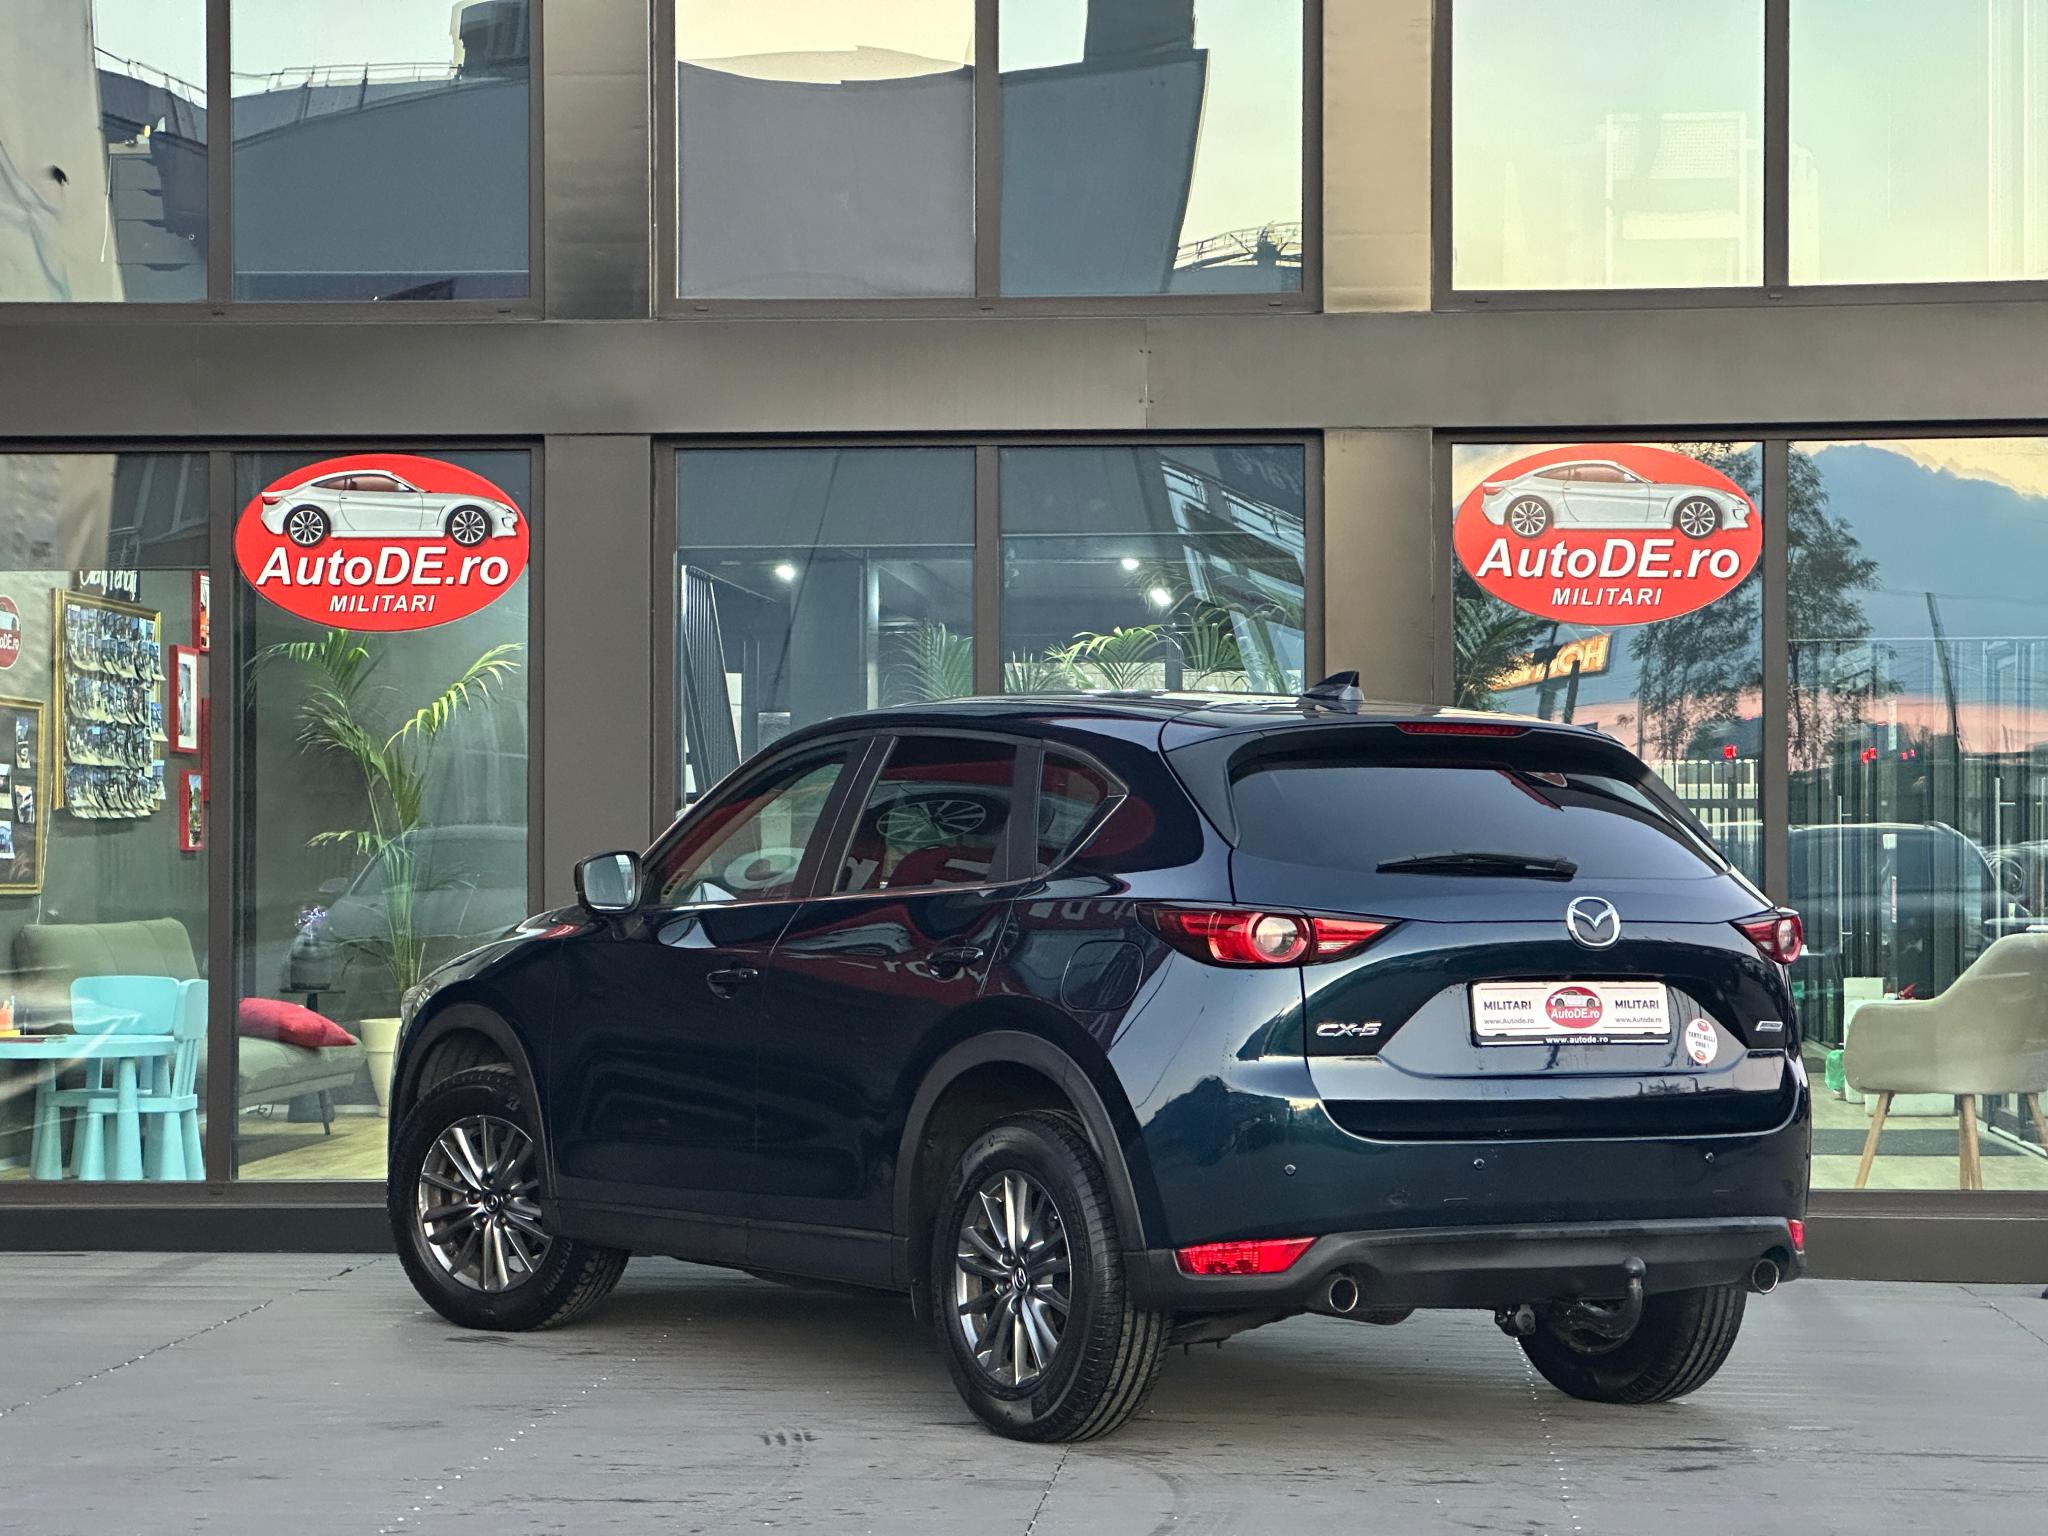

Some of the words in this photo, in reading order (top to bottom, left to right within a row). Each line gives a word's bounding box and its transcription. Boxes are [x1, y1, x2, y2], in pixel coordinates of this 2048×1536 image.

[255, 546, 510, 586] AutoDE.ro
[1476, 538, 1741, 579] AutoDE.ro
[329, 594, 436, 612] MILITARI
[1551, 587, 1662, 606] MILITARI
[1483, 1000, 1532, 1011] MILITARI
[1615, 999, 1660, 1010] MILITARI
[1550, 1007, 1600, 1019] AutoDE.ro
[1316, 1022, 1382, 1037] CX-5
[1545, 1035, 1609, 1044] www.autode.ro
